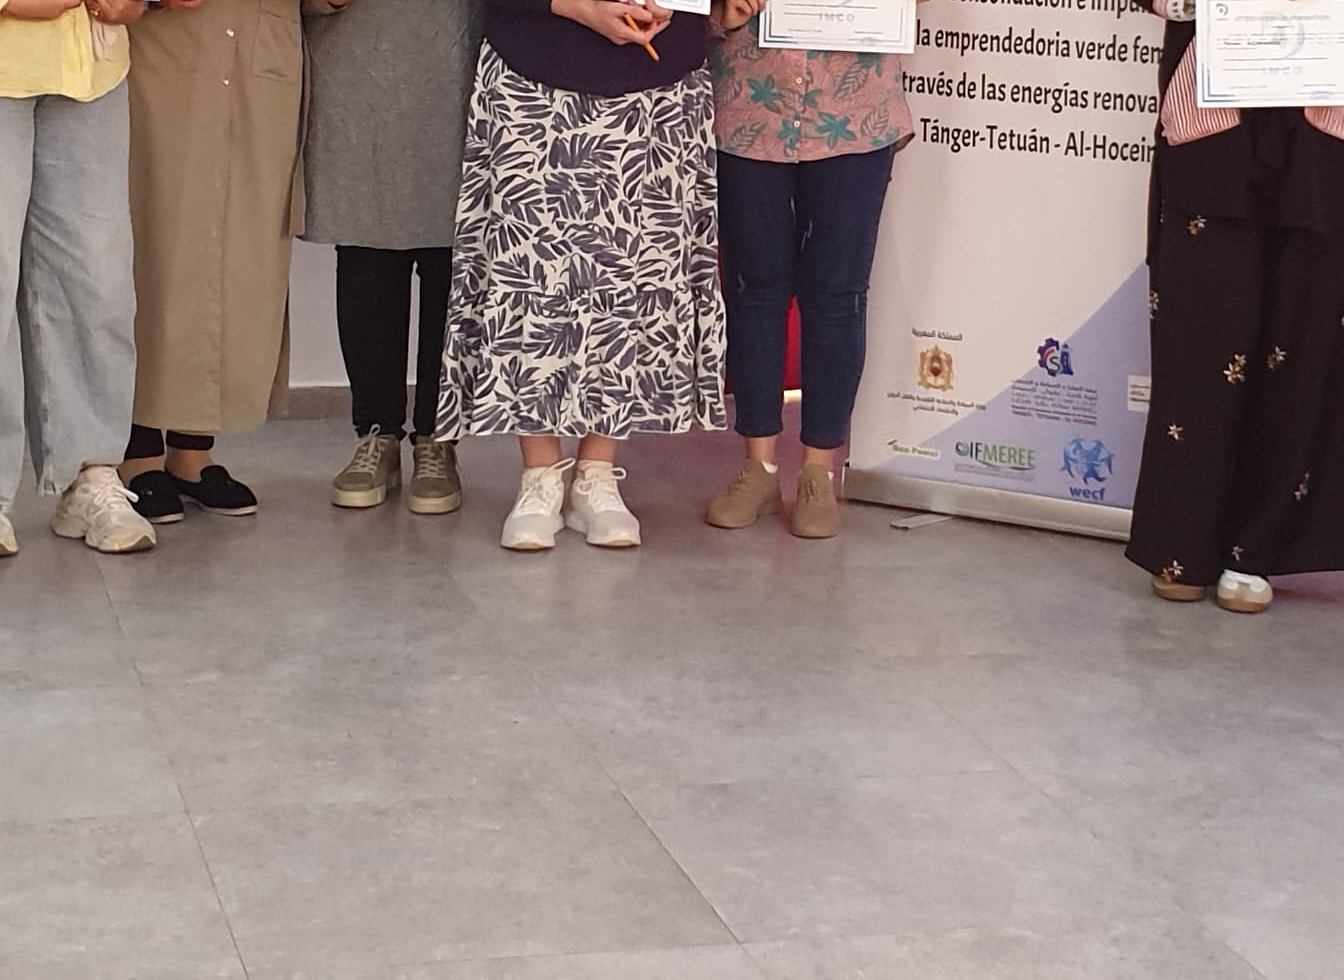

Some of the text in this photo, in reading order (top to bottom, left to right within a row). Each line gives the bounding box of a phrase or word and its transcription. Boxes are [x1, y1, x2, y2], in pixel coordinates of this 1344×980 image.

[916, 19, 931, 46] la
[935, 26, 1070, 57] emprendedoria
[1075, 34, 1128, 62] verde
[902, 71, 1158, 114] través de las energías renova
[919, 117, 1050, 154] Tánger-Tetuán
[1069, 486, 1106, 501] wecf
